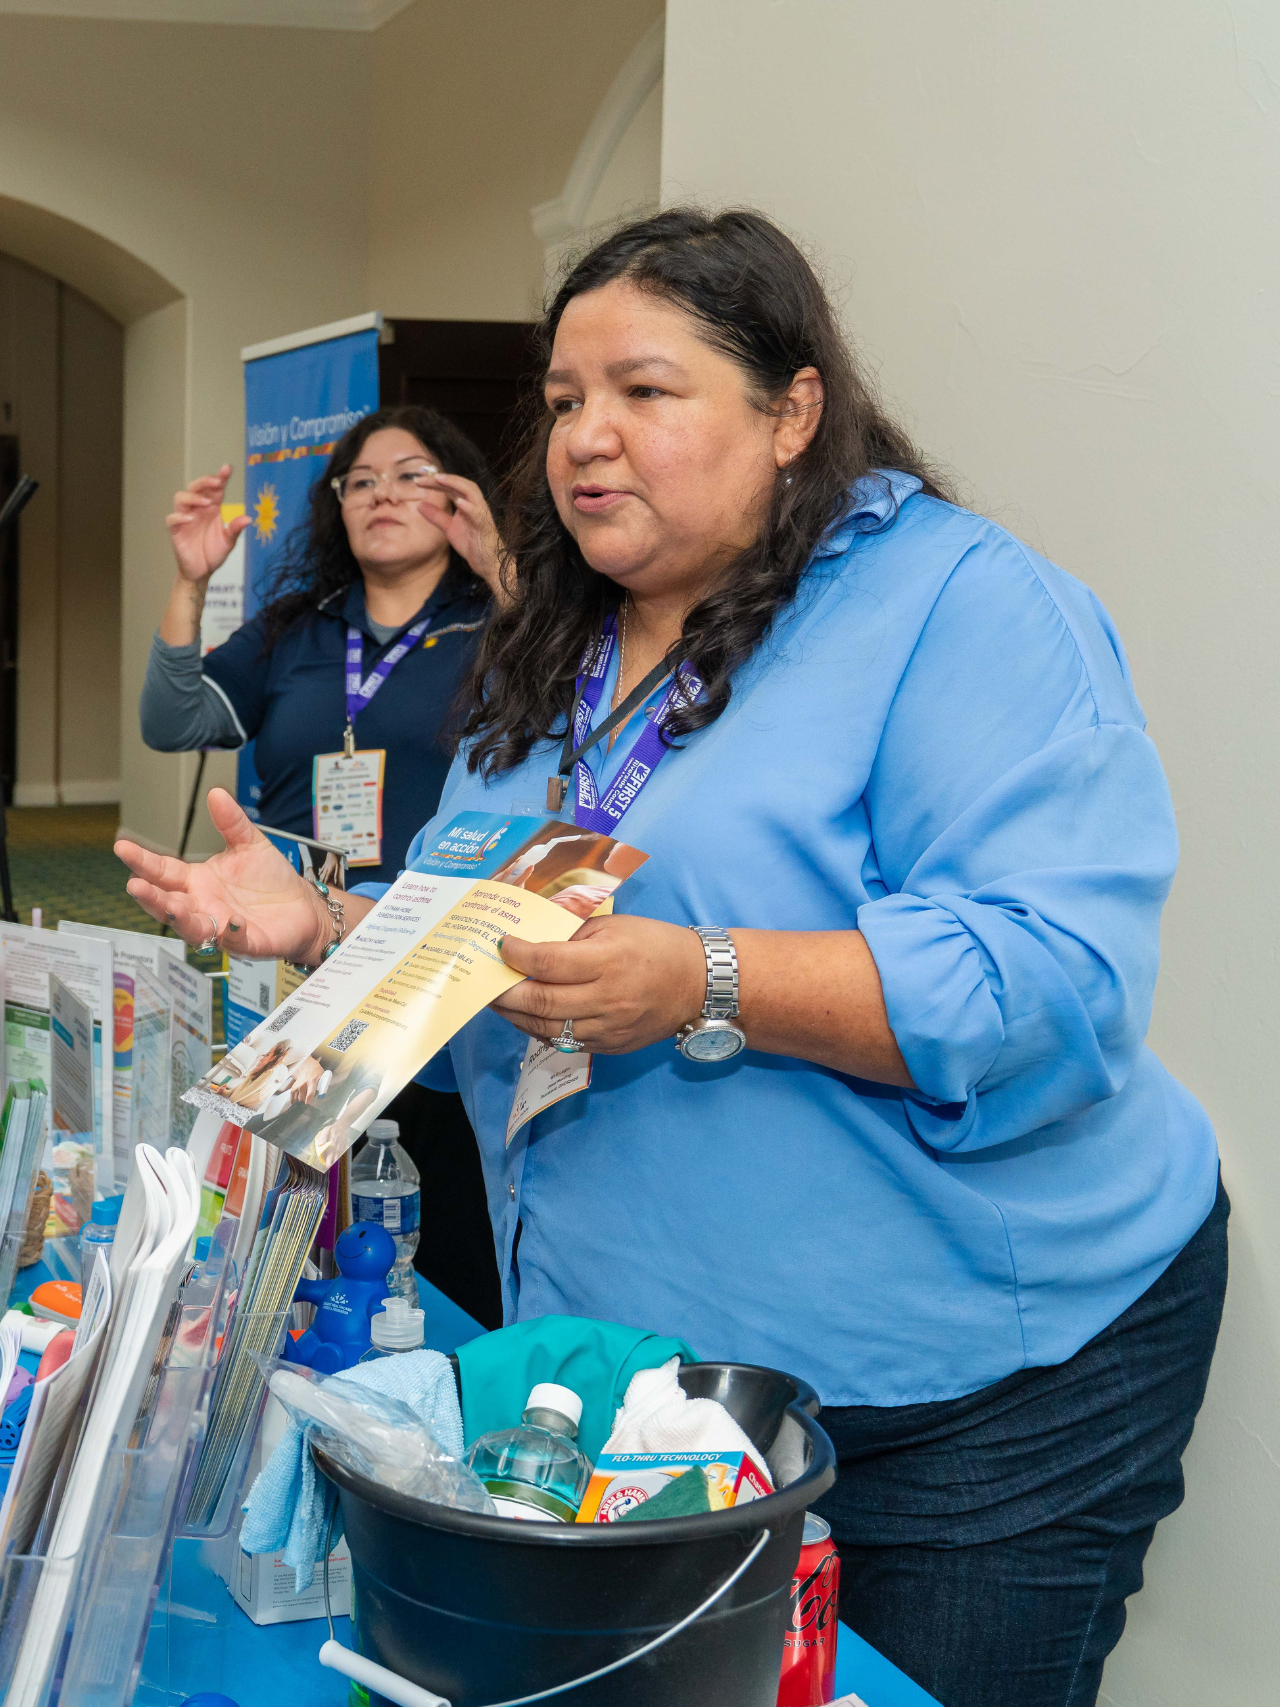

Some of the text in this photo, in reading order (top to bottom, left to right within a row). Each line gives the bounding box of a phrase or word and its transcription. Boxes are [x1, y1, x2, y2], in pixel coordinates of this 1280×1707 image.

[4, 402, 13, 422] 1
[247, 422, 279, 447] Visión
[603, 758, 640, 812] Riverside County
[607, 776, 645, 820] FIRST 5
[447, 827, 489, 842] Mi salud
[438, 840, 480, 855] en acción
[401, 882, 419, 891] Learn
[419, 884, 429, 892] how
[392, 893, 433, 904] control asthma
[471, 889, 522, 909] Aprende cómo
[461, 901, 522, 925] controlar el asma
[449, 914, 473, 924] SERVICIOS
[480, 920, 507, 937] REMEDIA
[451, 923, 468, 932] HOGAR
[468, 926, 482, 935] PARA
[481, 931, 489, 941] EL
[425, 945, 475, 966] HOGARES SALUDABLES
[611, 1453, 723, 1463] FLO-THRU TECHNOLOGY
[600, 1496, 617, 1515] ARM
[616, 1491, 623, 1499] &
[783, 1637, 826, 1649] SUGAR
